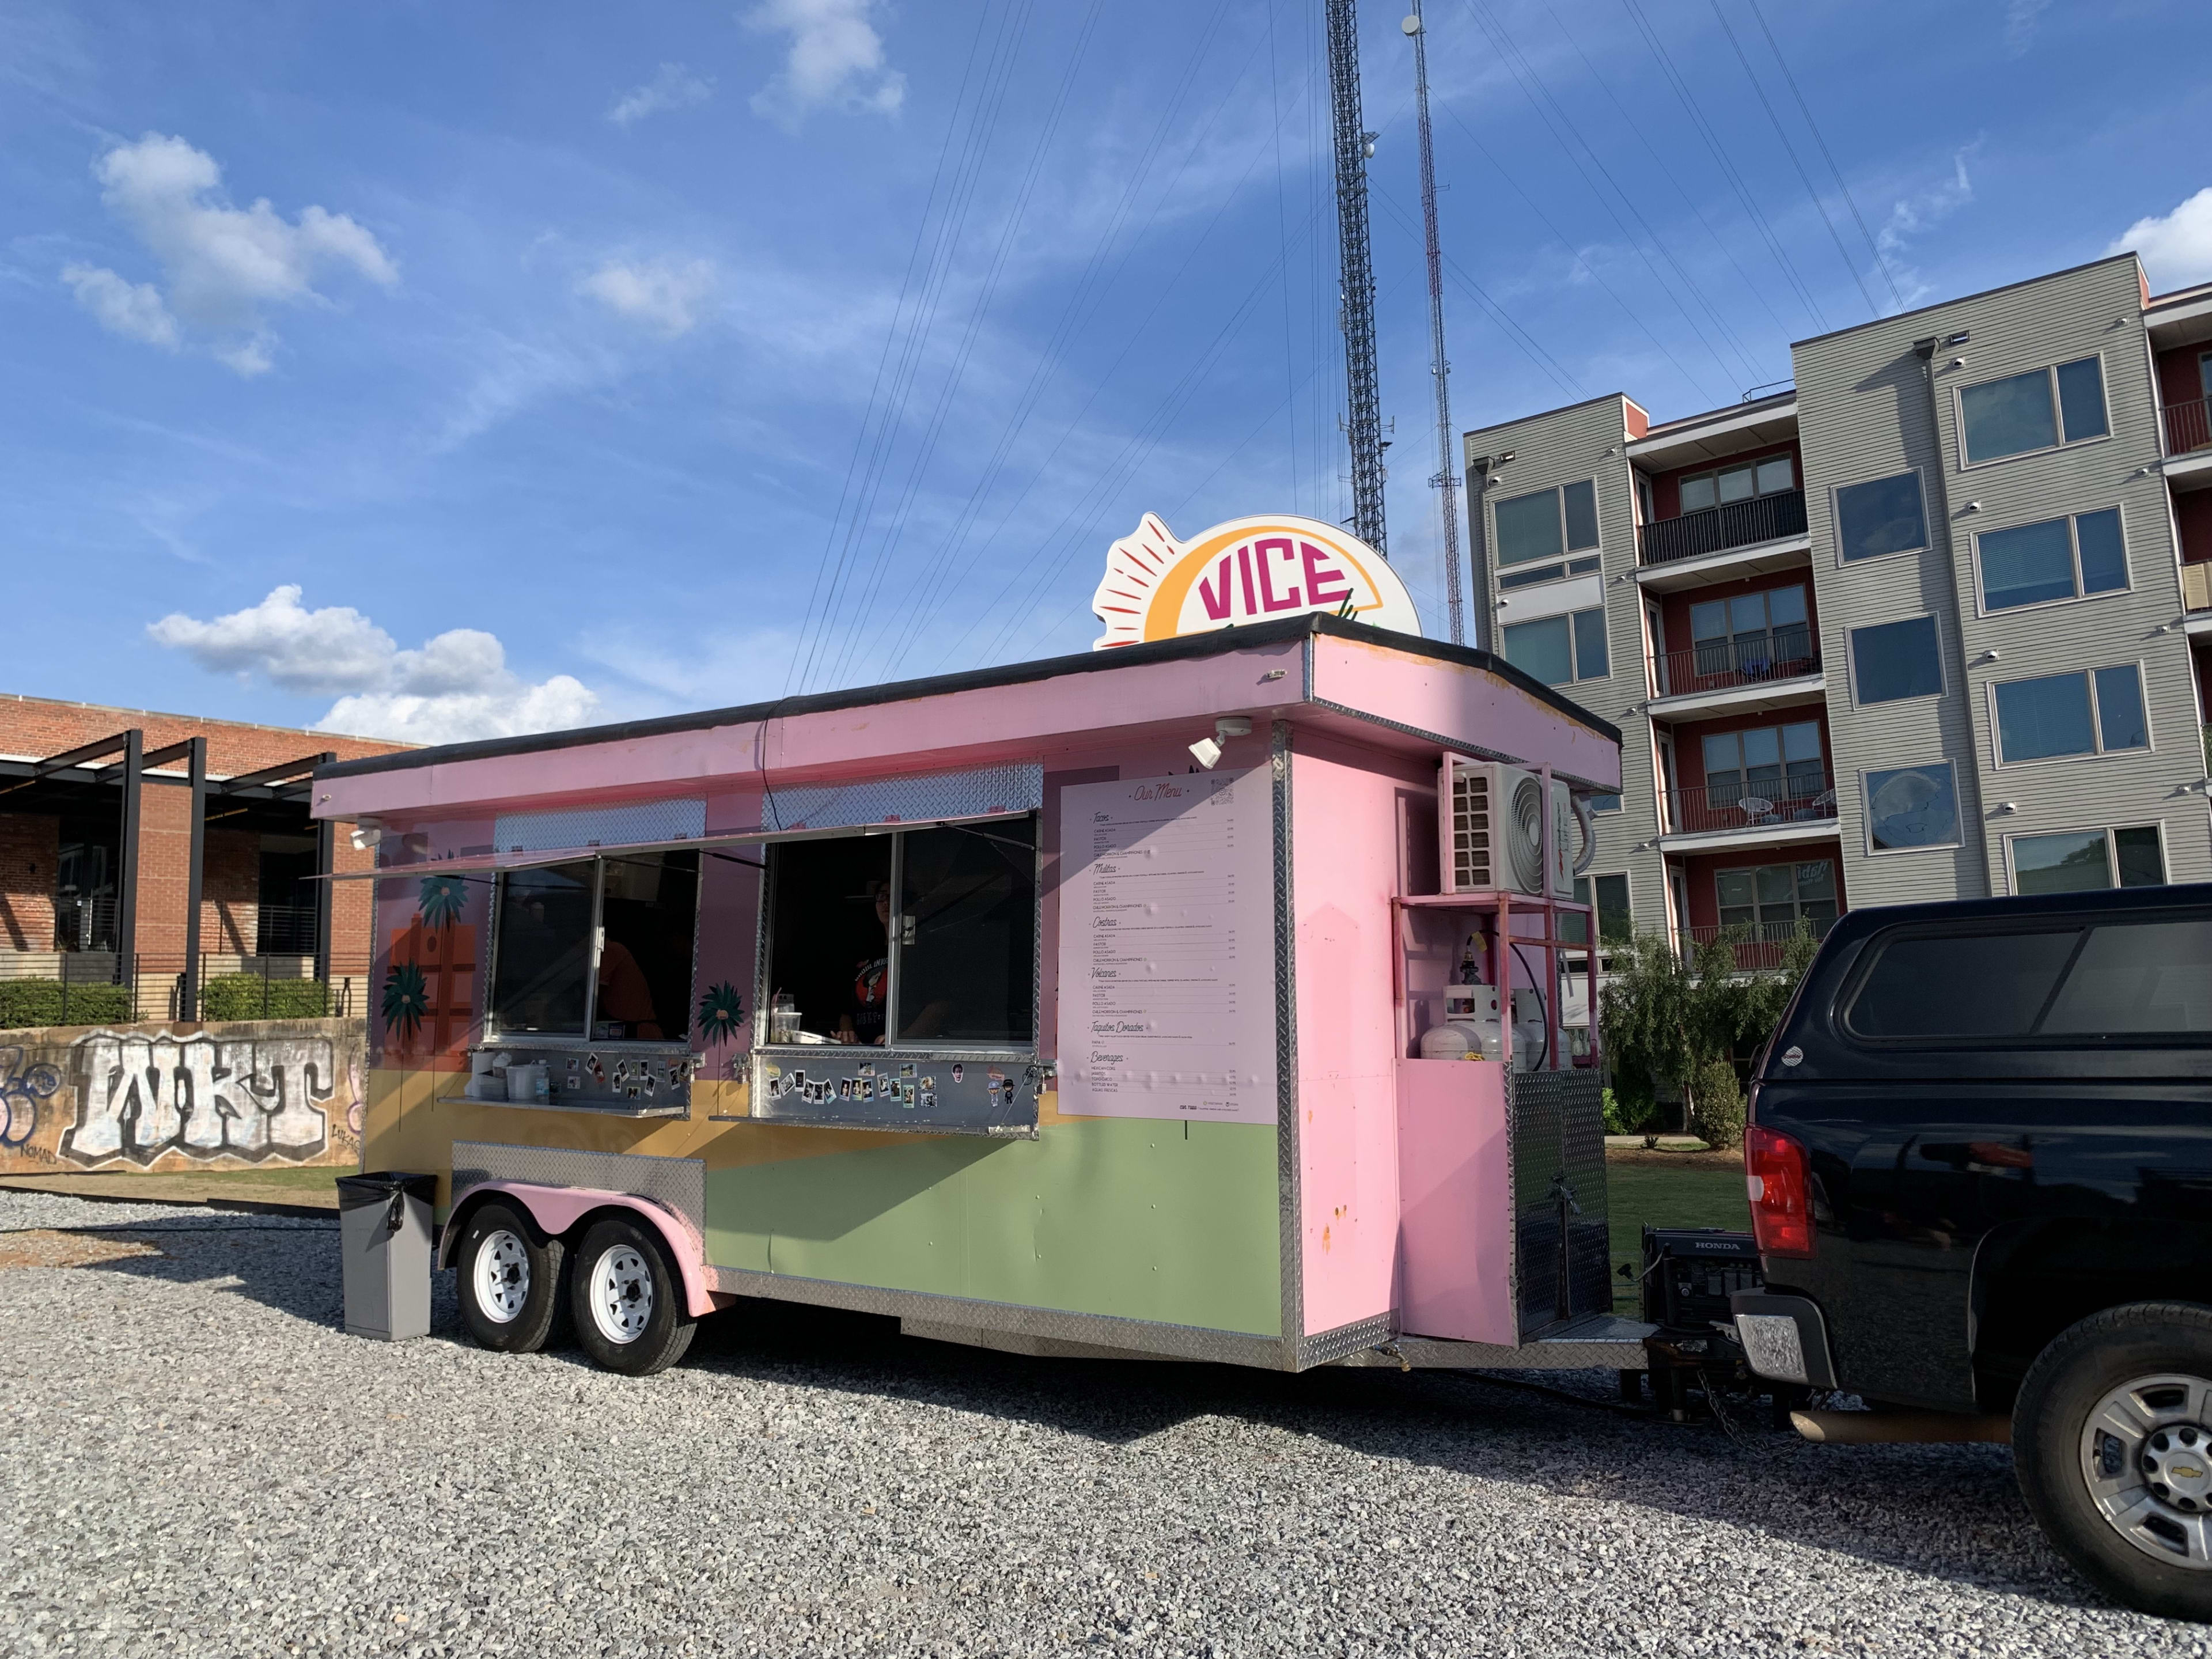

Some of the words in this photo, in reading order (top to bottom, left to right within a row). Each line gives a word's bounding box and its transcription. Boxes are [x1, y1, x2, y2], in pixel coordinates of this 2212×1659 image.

[1199, 538, 1351, 620] VICE
[1134, 785, 1153, 801] Our
[1154, 783, 1182, 801] Menu
[1093, 812, 1109, 824] Tacos
[1093, 863, 1116, 876] Mulitas
[1093, 916, 1117, 929] Costras
[1092, 967, 1117, 979] Volcanes
[1091, 1020, 1115, 1035] Taquitos
[1115, 1020, 1143, 1033] Dorados
[1090, 1051, 1123, 1065] Beverages
[21, 1144, 57, 1165] NOMAD
[1695, 1242, 1740, 1250] HONDA
